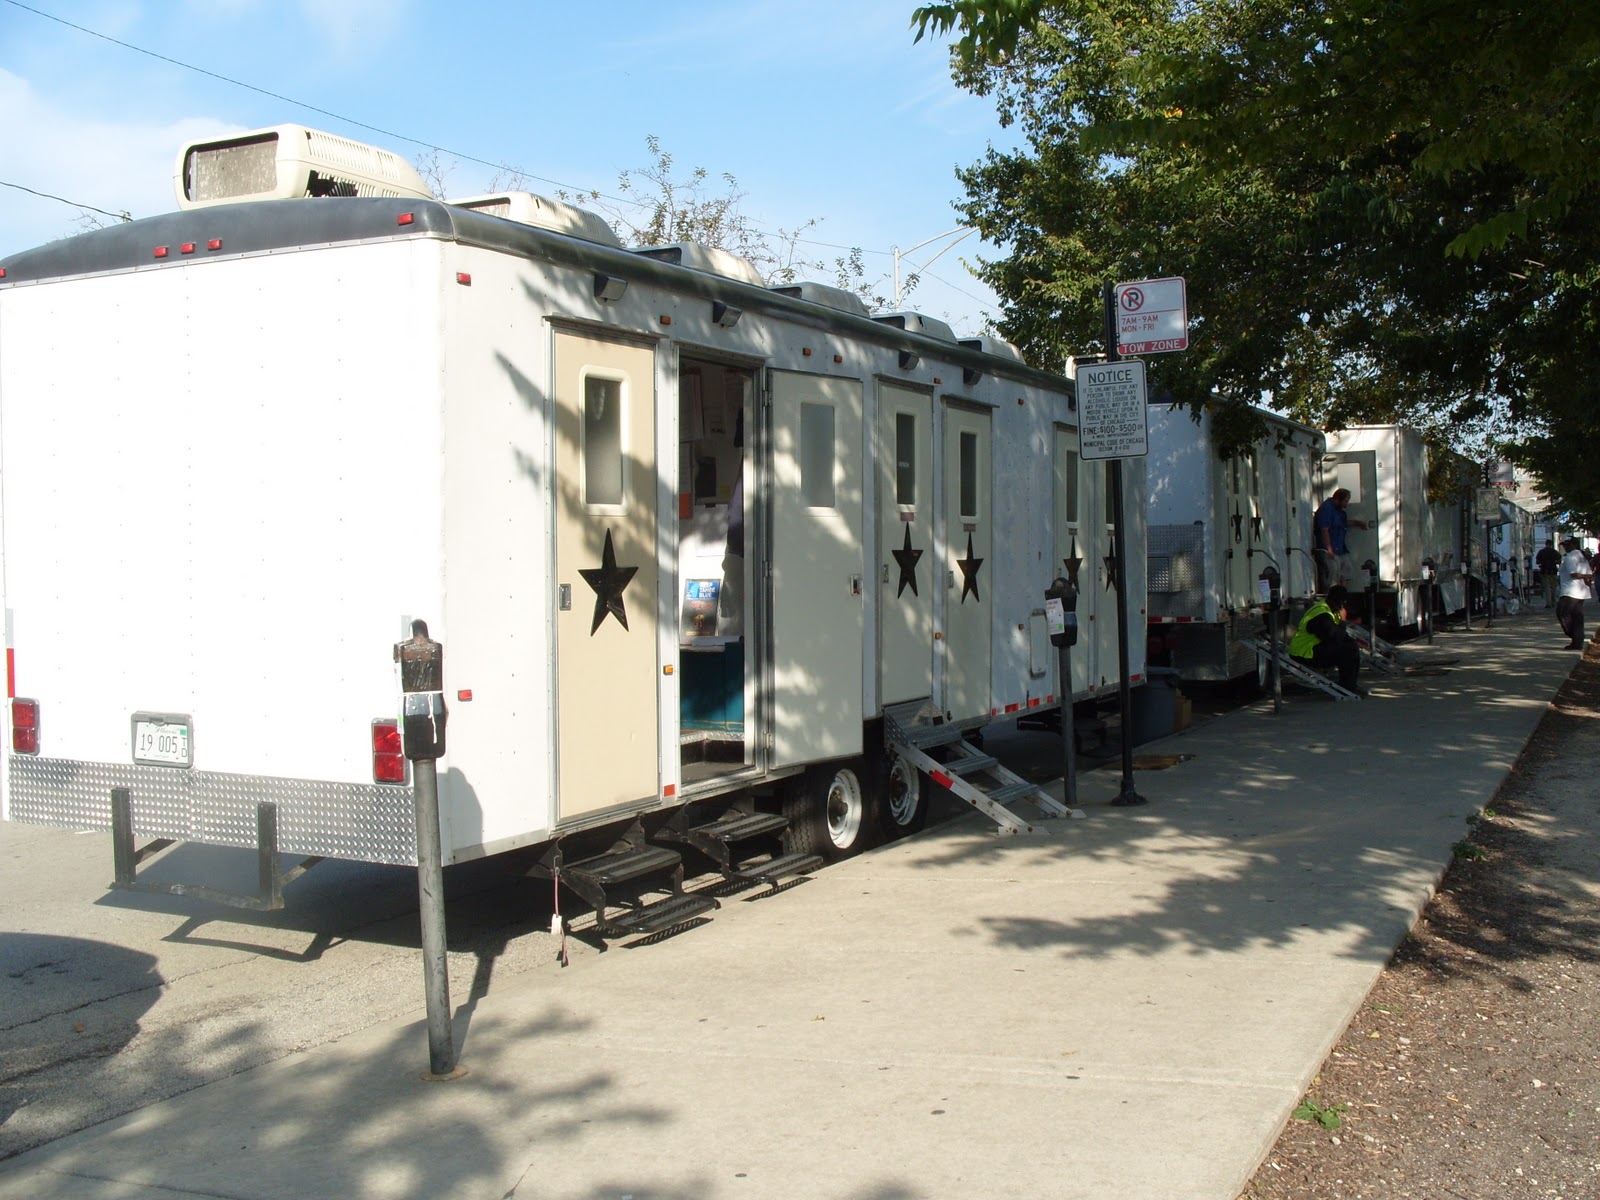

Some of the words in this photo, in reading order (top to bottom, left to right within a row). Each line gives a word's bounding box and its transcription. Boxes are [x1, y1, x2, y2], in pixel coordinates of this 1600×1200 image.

[1121, 317, 1137, 325] 7AM
[1142, 315, 1158, 323] 9AM
[1121, 325, 1137, 333] MON
[1143, 323, 1154, 331] FRI
[1122, 343, 1145, 353] TOW
[1151, 340, 1180, 351] ZONE
[1088, 369, 1133, 384] NOTICE
[1125, 437, 1144, 445] CHICAGO
[140, 733, 153, 751] 19
[159, 735, 178, 754] 005
